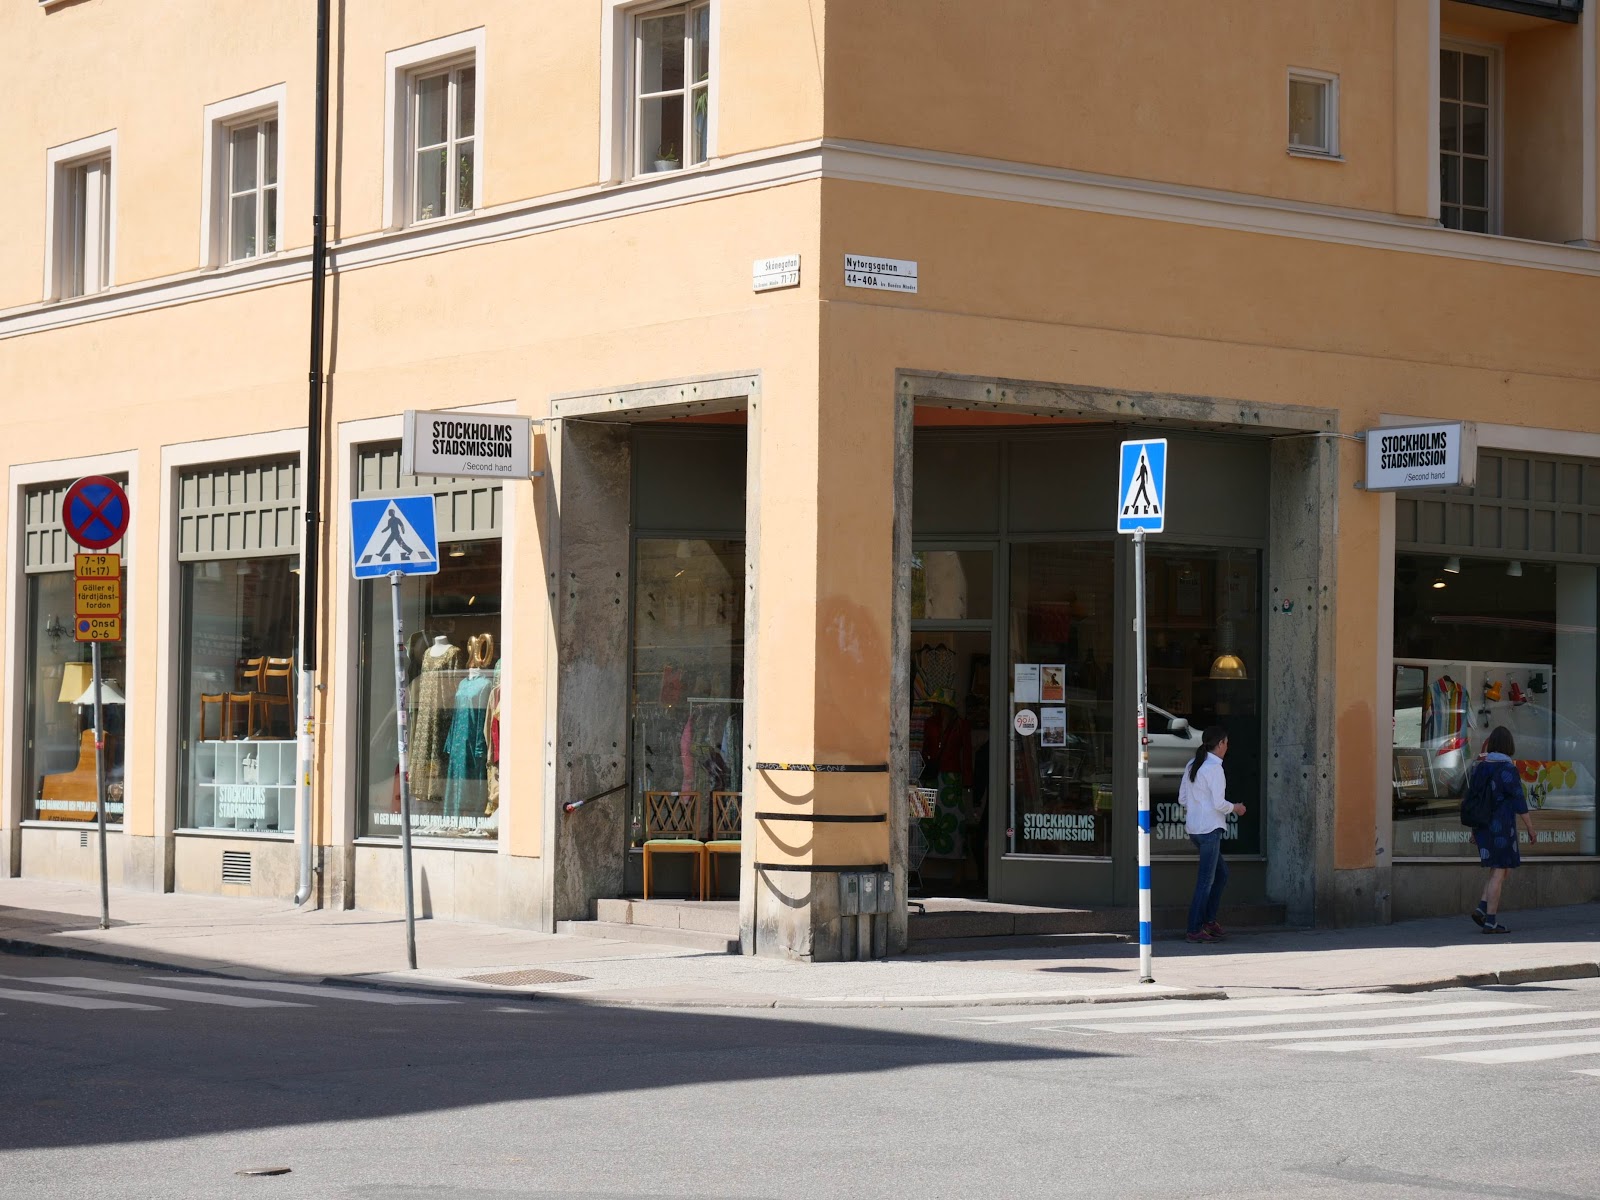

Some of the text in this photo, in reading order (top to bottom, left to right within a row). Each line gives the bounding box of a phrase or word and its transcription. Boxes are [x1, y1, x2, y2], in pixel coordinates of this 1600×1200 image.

[765, 258, 798, 271] Skånegatan
[847, 257, 898, 272] Nytorgsgatan
[781, 273, 797, 283] 71-77
[847, 274, 878, 286] 44-40A
[432, 421, 512, 442] STOCKHOLMS
[432, 439, 512, 458] STADSMISSION
[1381, 431, 1447, 453] STOCKHOLMS
[1381, 450, 1446, 470] STADSMISSION
[494, 463, 512, 472] hand
[1430, 471, 1446, 480] hand
[84, 557, 106, 565] 7-19
[81, 566, 110, 576] (11-17)
[107, 585, 115, 593] ej
[78, 593, 119, 602] färdtjänst-
[91, 619, 115, 628] Onsd
[91, 630, 110, 638] 0-6
[219, 785, 266, 803] STOCKHOLMS
[219, 803, 266, 820] STADSMISSION
[1023, 813, 1095, 829] STOCKHOLMS
[1023, 827, 1095, 842] STADSMISSION
[1412, 829, 1576, 843] VI GER MÄNNISKO EN NDRA CHANS
